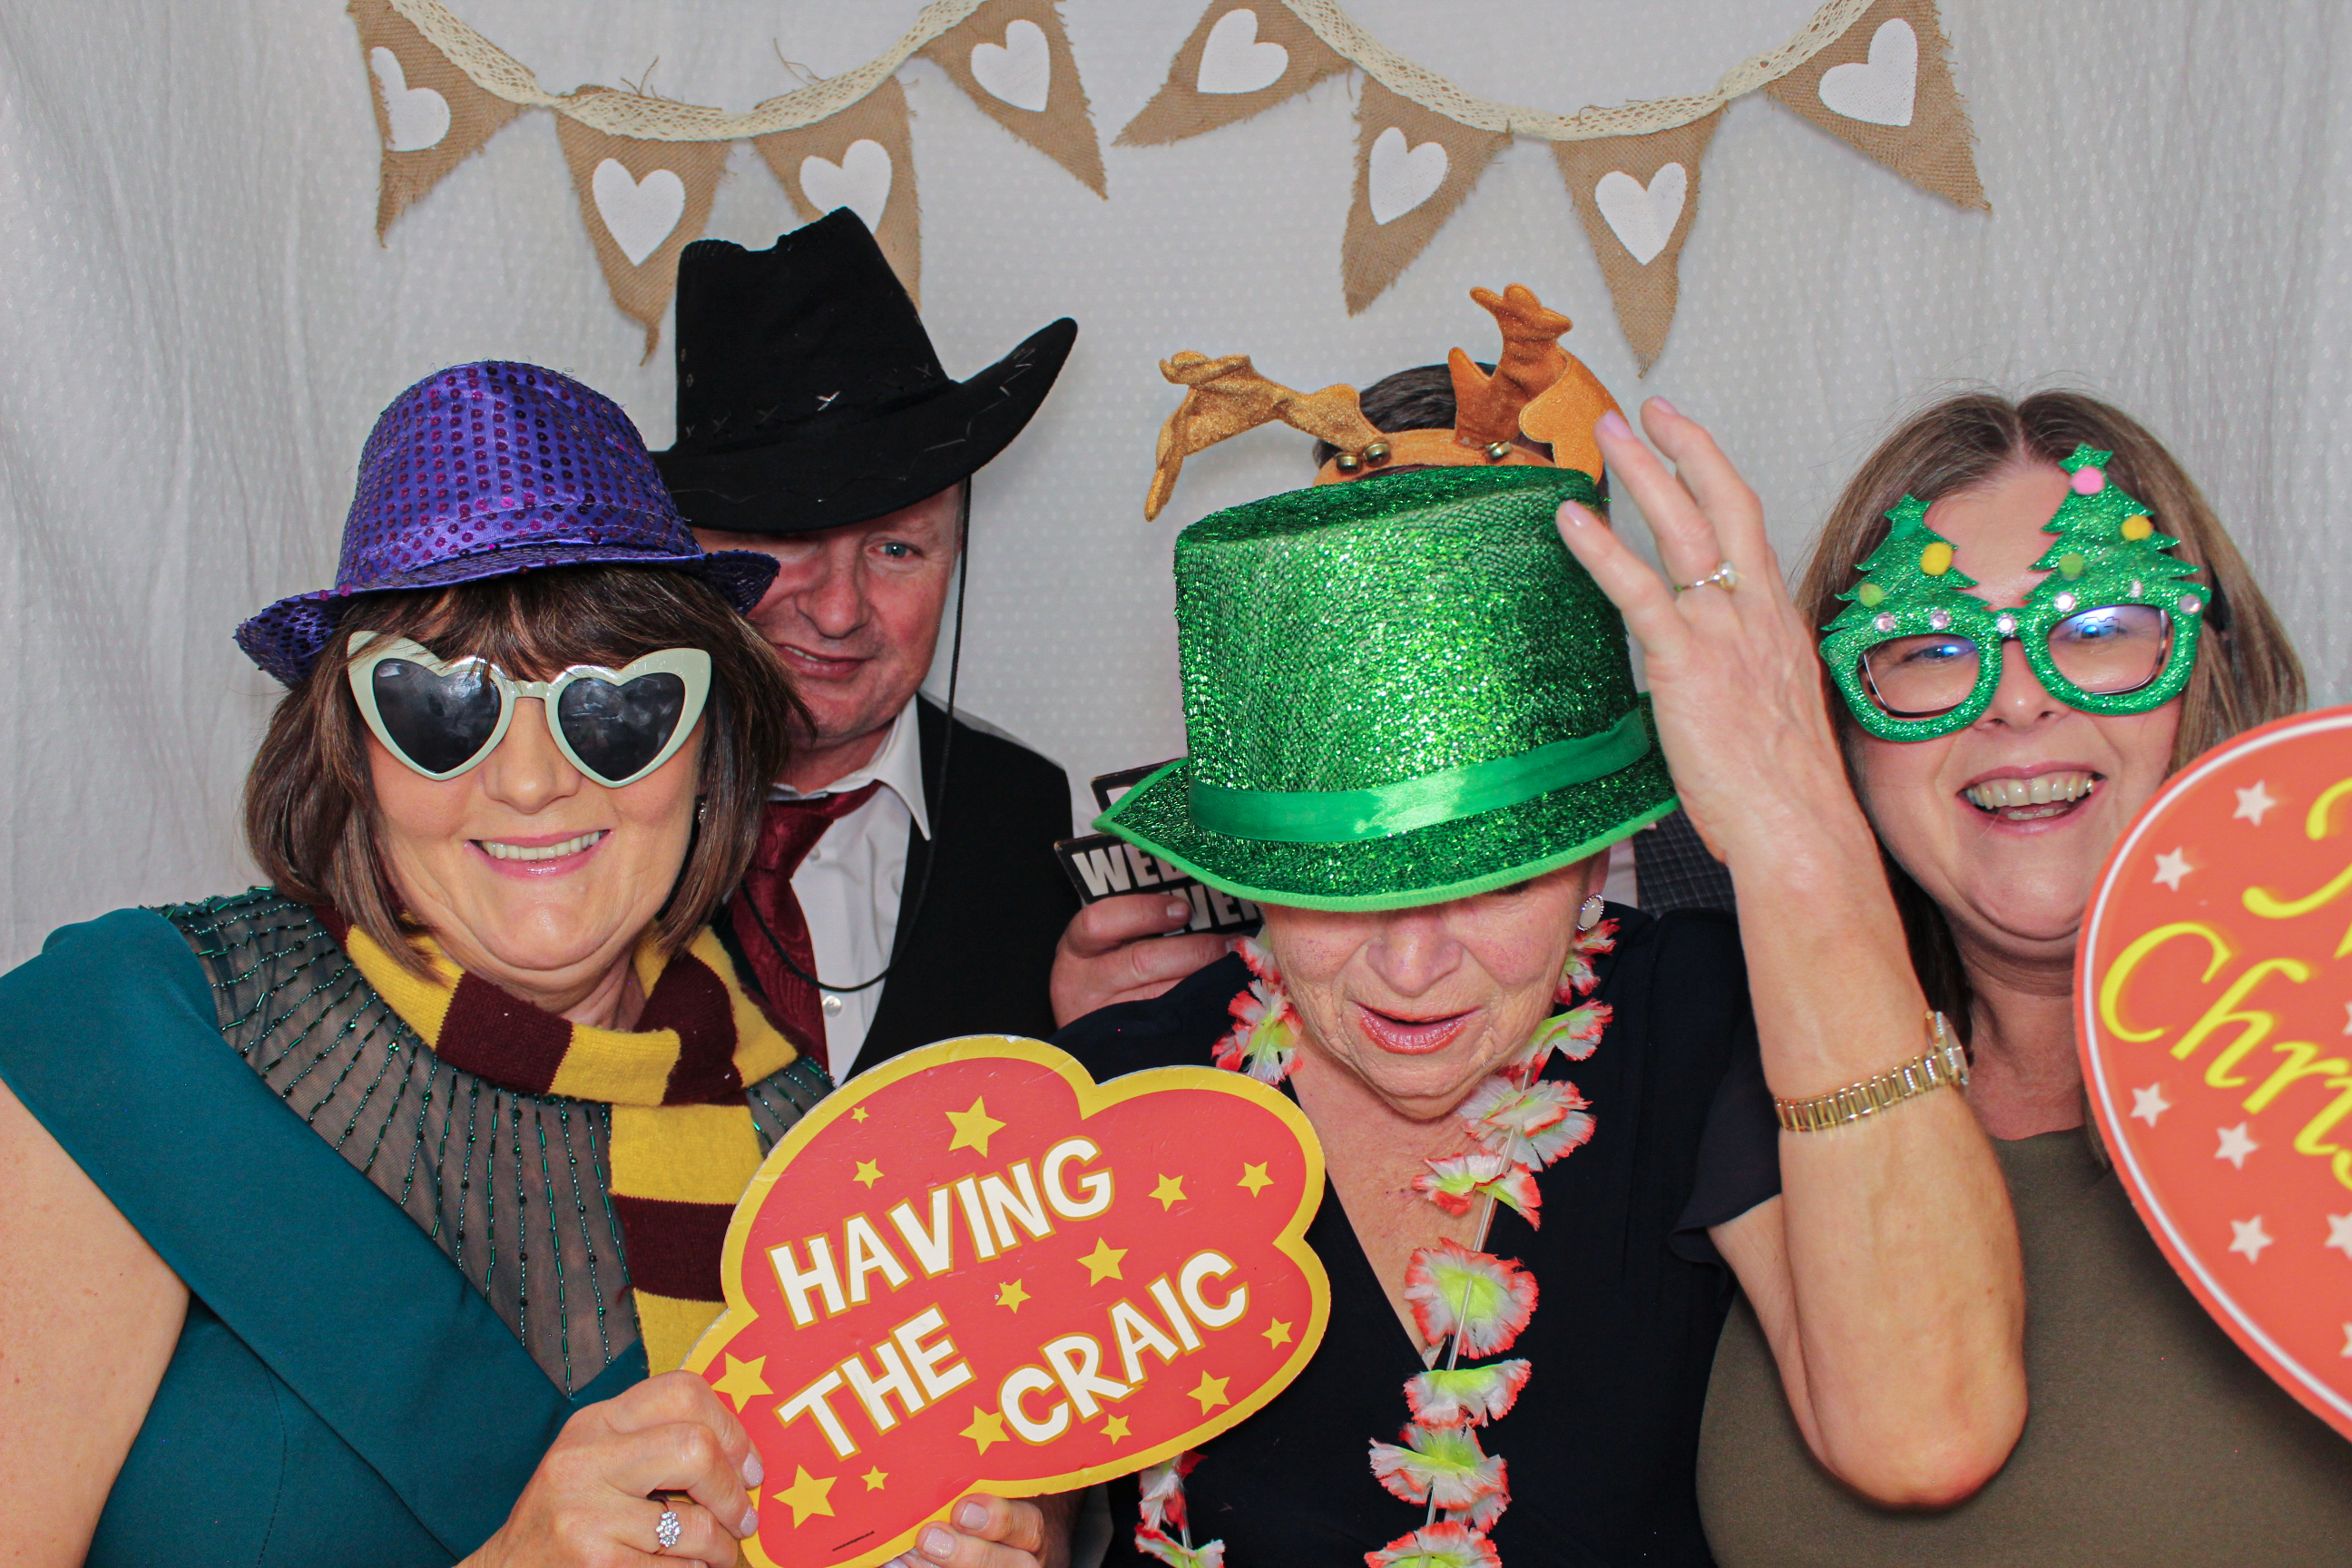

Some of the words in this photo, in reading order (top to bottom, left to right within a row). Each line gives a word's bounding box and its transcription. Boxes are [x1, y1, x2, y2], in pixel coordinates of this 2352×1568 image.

[768, 1137, 1113, 1328] HAVING
[776, 1306, 975, 1459] THE
[998, 1250, 1248, 1444] CRAIC
